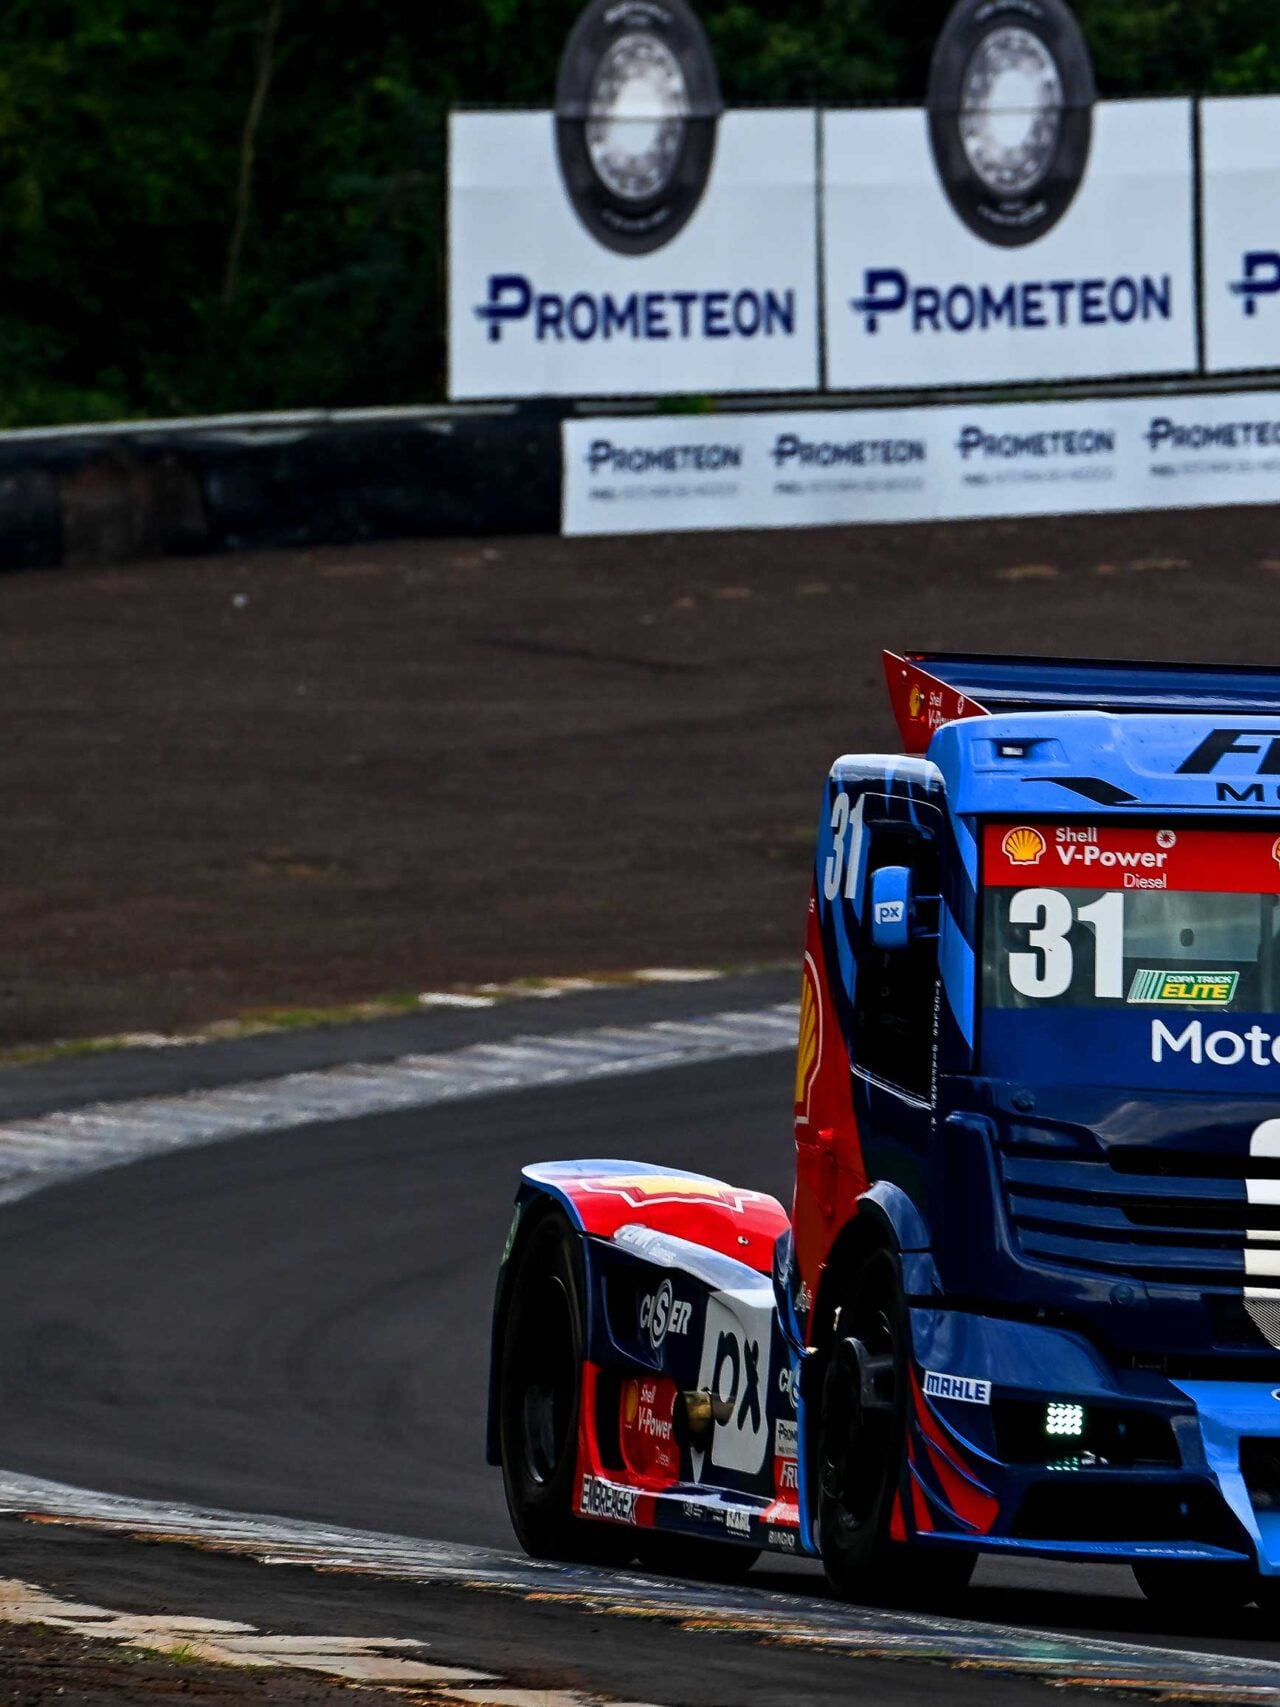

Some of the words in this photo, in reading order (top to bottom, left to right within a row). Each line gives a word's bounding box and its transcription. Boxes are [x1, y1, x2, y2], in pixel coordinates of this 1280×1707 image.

[473, 274, 796, 342] PROMETEON
[851, 268, 1171, 335] PROMETEON
[586, 439, 743, 476] PROMETEON
[771, 433, 927, 467] PROMETEON
[956, 425, 1114, 459] PROMETEON
[824, 792, 866, 900] 31
[1056, 827, 1098, 844] Shell
[1056, 845, 1168, 869] V-Power
[1124, 873, 1167, 889] Diesel
[1008, 888, 1124, 998] 31
[1161, 983, 1230, 998] ELITE
[1197, 975, 1233, 984] TRUCK
[640, 1283, 693, 1342] CISER
[926, 1374, 987, 1402] MAHLE
[638, 1406, 673, 1440] V-Power
